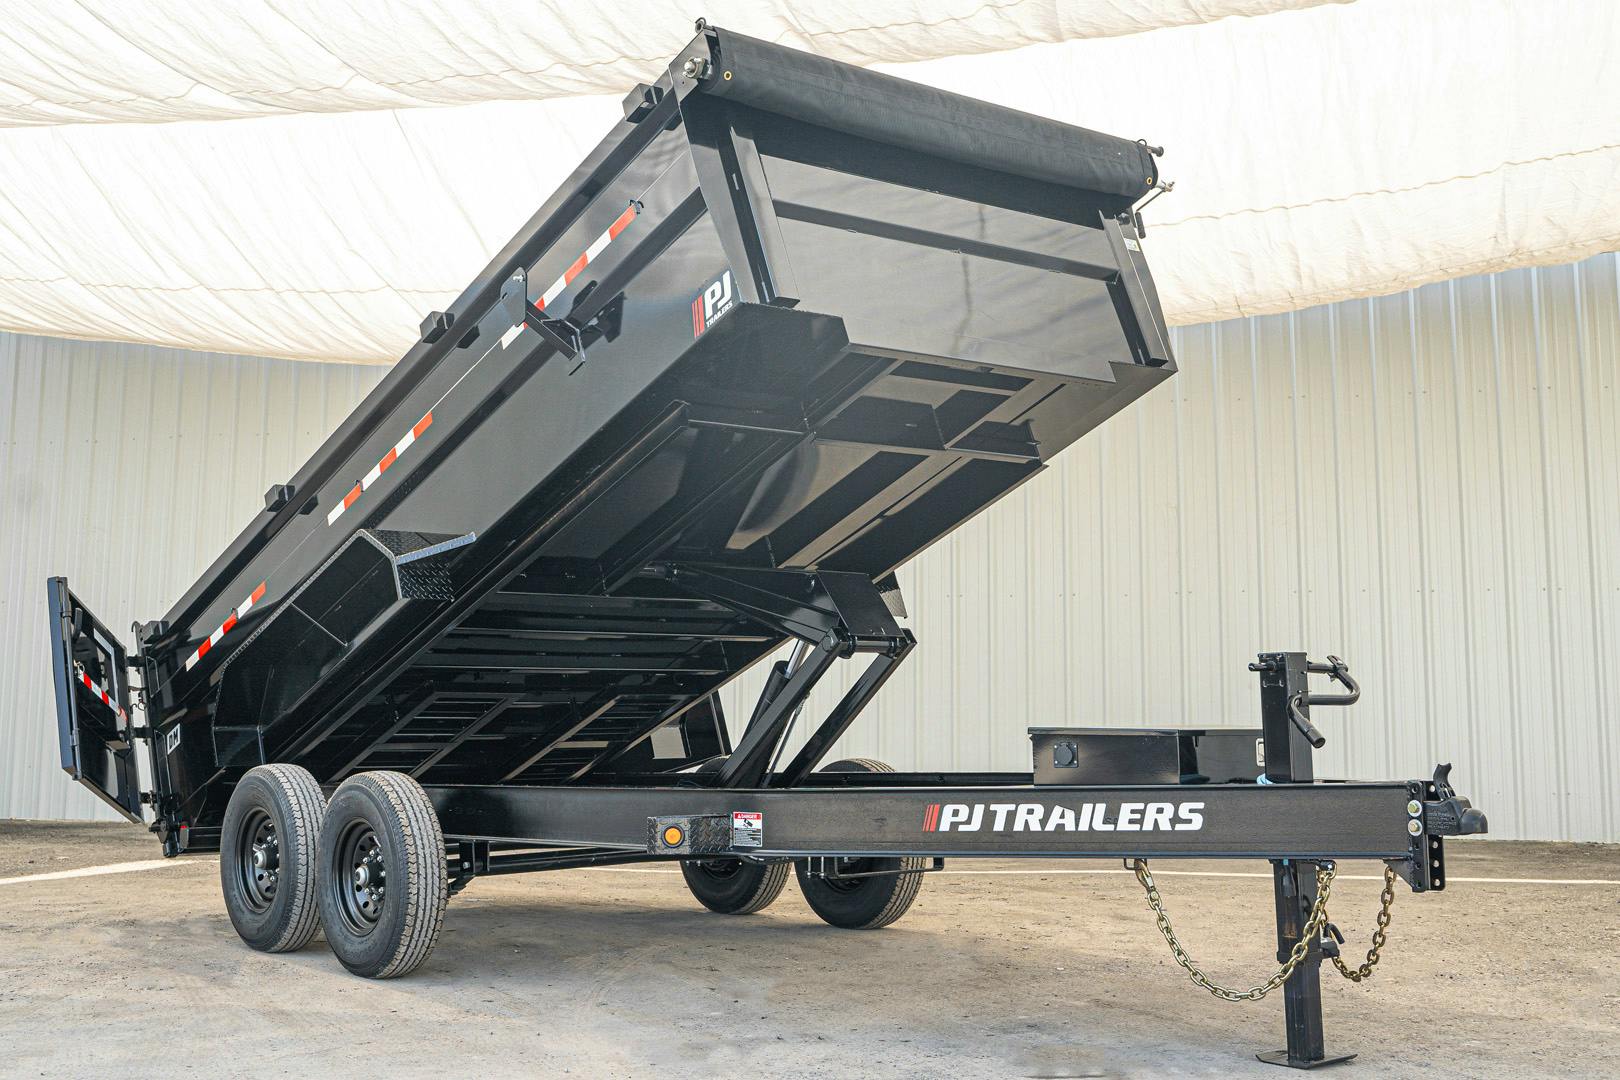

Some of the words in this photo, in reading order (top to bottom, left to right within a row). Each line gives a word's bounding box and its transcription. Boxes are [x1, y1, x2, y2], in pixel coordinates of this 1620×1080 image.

[704, 270, 732, 320] PJ
[706, 300, 733, 328] TRAILERS
[939, 804, 985, 831] PJ
[989, 802, 1205, 831] TRAILERS
